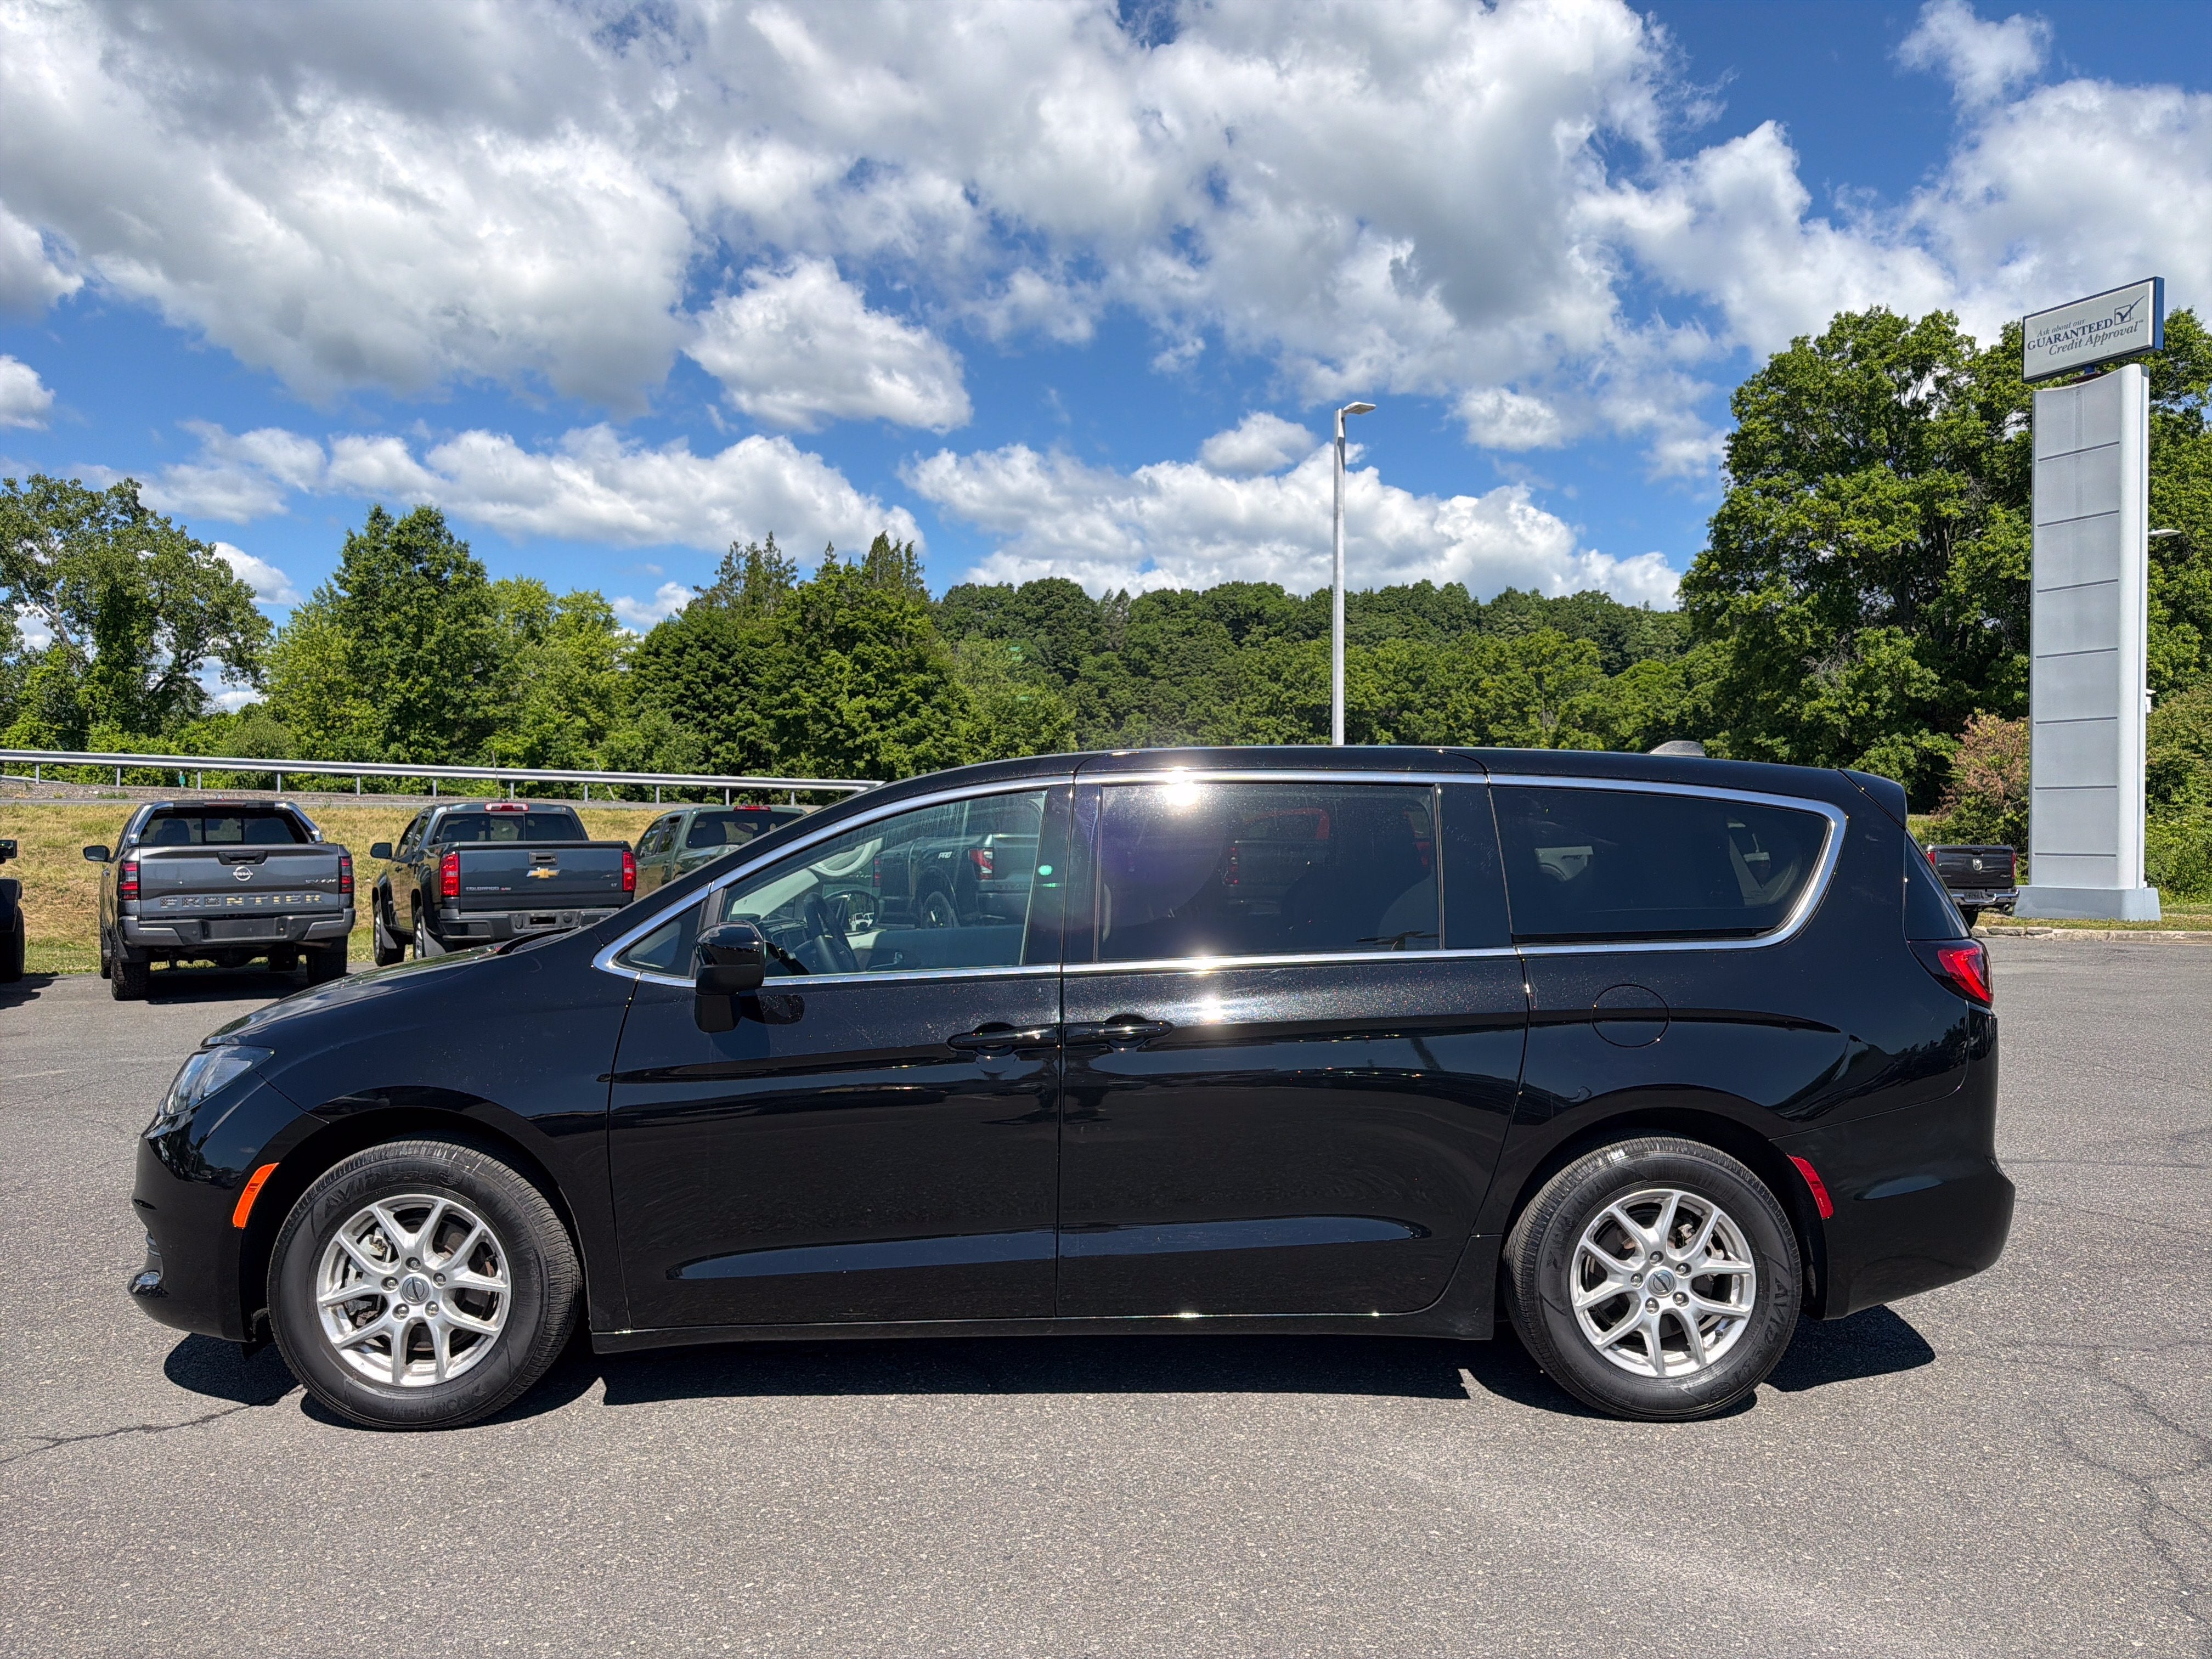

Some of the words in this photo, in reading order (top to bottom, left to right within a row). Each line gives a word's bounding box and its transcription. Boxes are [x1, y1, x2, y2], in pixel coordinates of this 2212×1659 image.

[2027, 318, 2113, 351] GUARANTEED
[2037, 328, 2050, 337] Ask
[2052, 321, 2071, 333] about
[2073, 319, 2086, 329] our
[2049, 338, 2083, 356] Credit
[2085, 321, 2138, 347] Approval
[160, 893, 323, 909] FRONTIER
